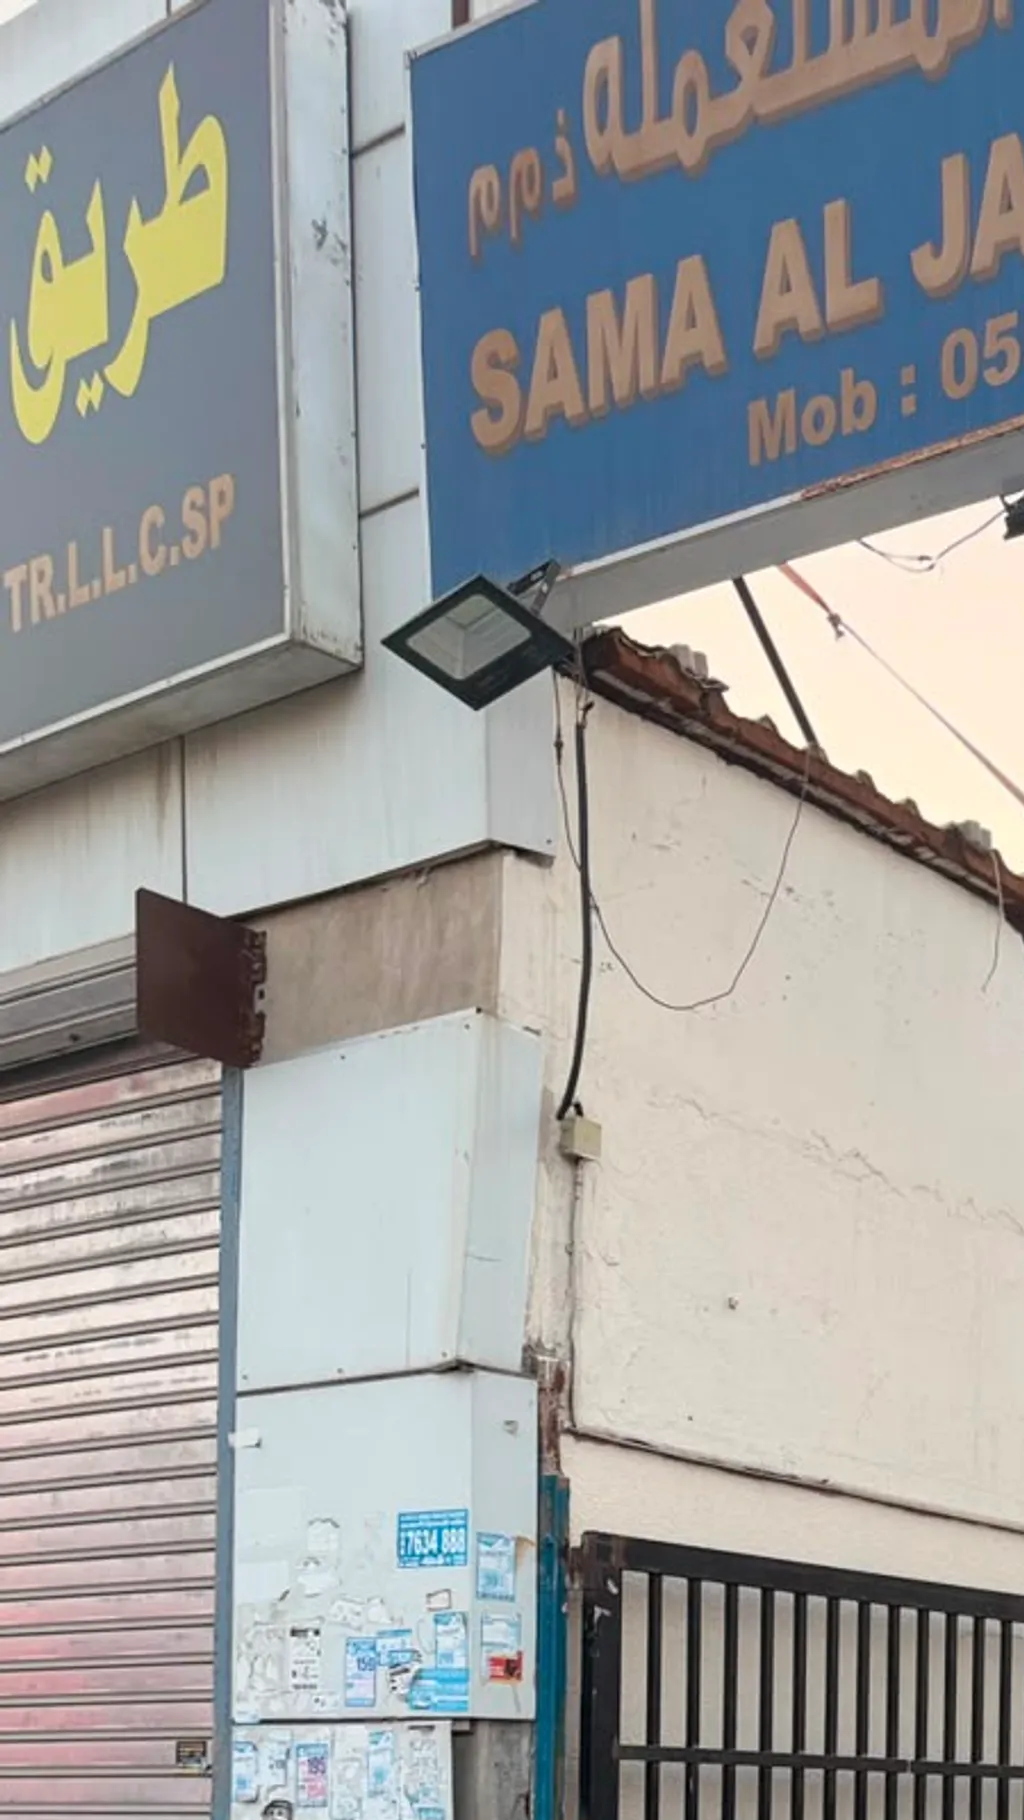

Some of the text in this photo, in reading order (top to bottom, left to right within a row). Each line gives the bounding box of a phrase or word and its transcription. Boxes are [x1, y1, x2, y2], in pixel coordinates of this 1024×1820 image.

[10, 61, 229, 445] طريق
[470, 254, 728, 456] SAMA
[753, 199, 884, 358] AL
[748, 368, 877, 467] Mob
[4, 473, 235, 633] TR.L.L.C.SP
